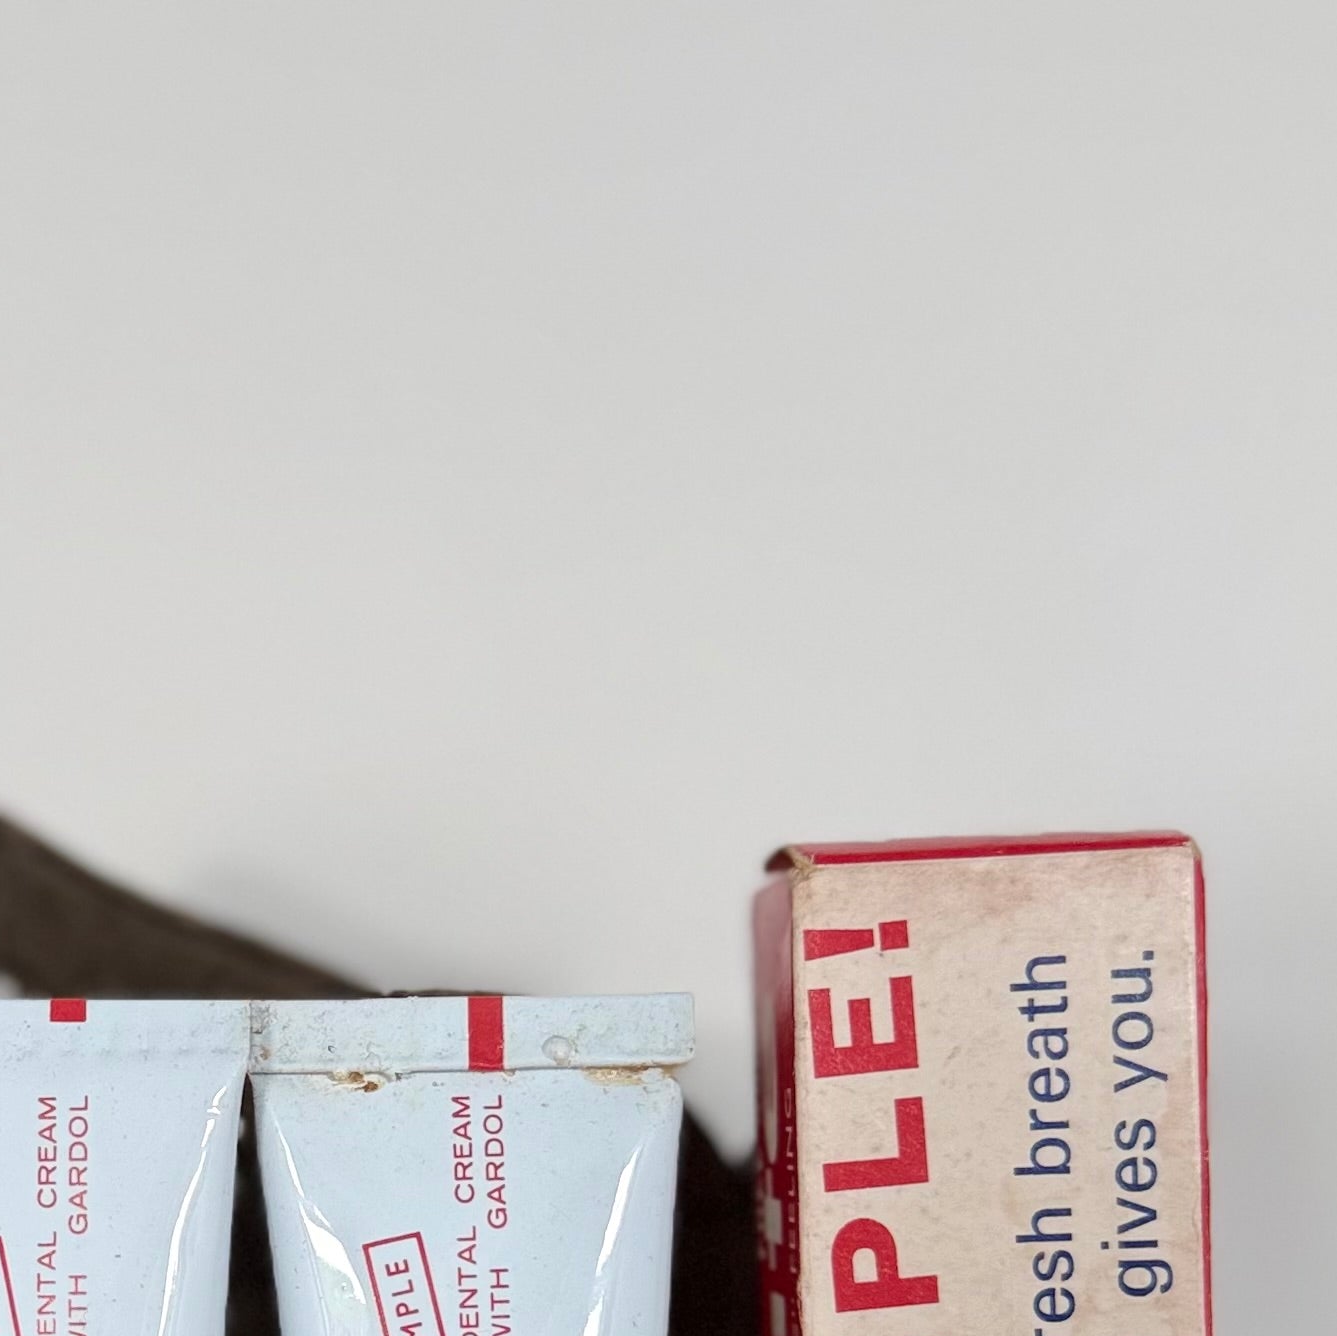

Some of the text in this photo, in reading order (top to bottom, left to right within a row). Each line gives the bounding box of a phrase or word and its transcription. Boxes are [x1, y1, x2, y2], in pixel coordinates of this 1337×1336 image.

[1009, 954, 1071, 1177] breath
[1110, 950, 1168, 1093] you.
[37, 1096, 57, 1208] CREAM
[68, 1095, 89, 1234] GARDOL
[452, 1095, 475, 1203] CREAM
[483, 1094, 507, 1229] GARDOL
[1101, 1118, 1173, 1297] gives
